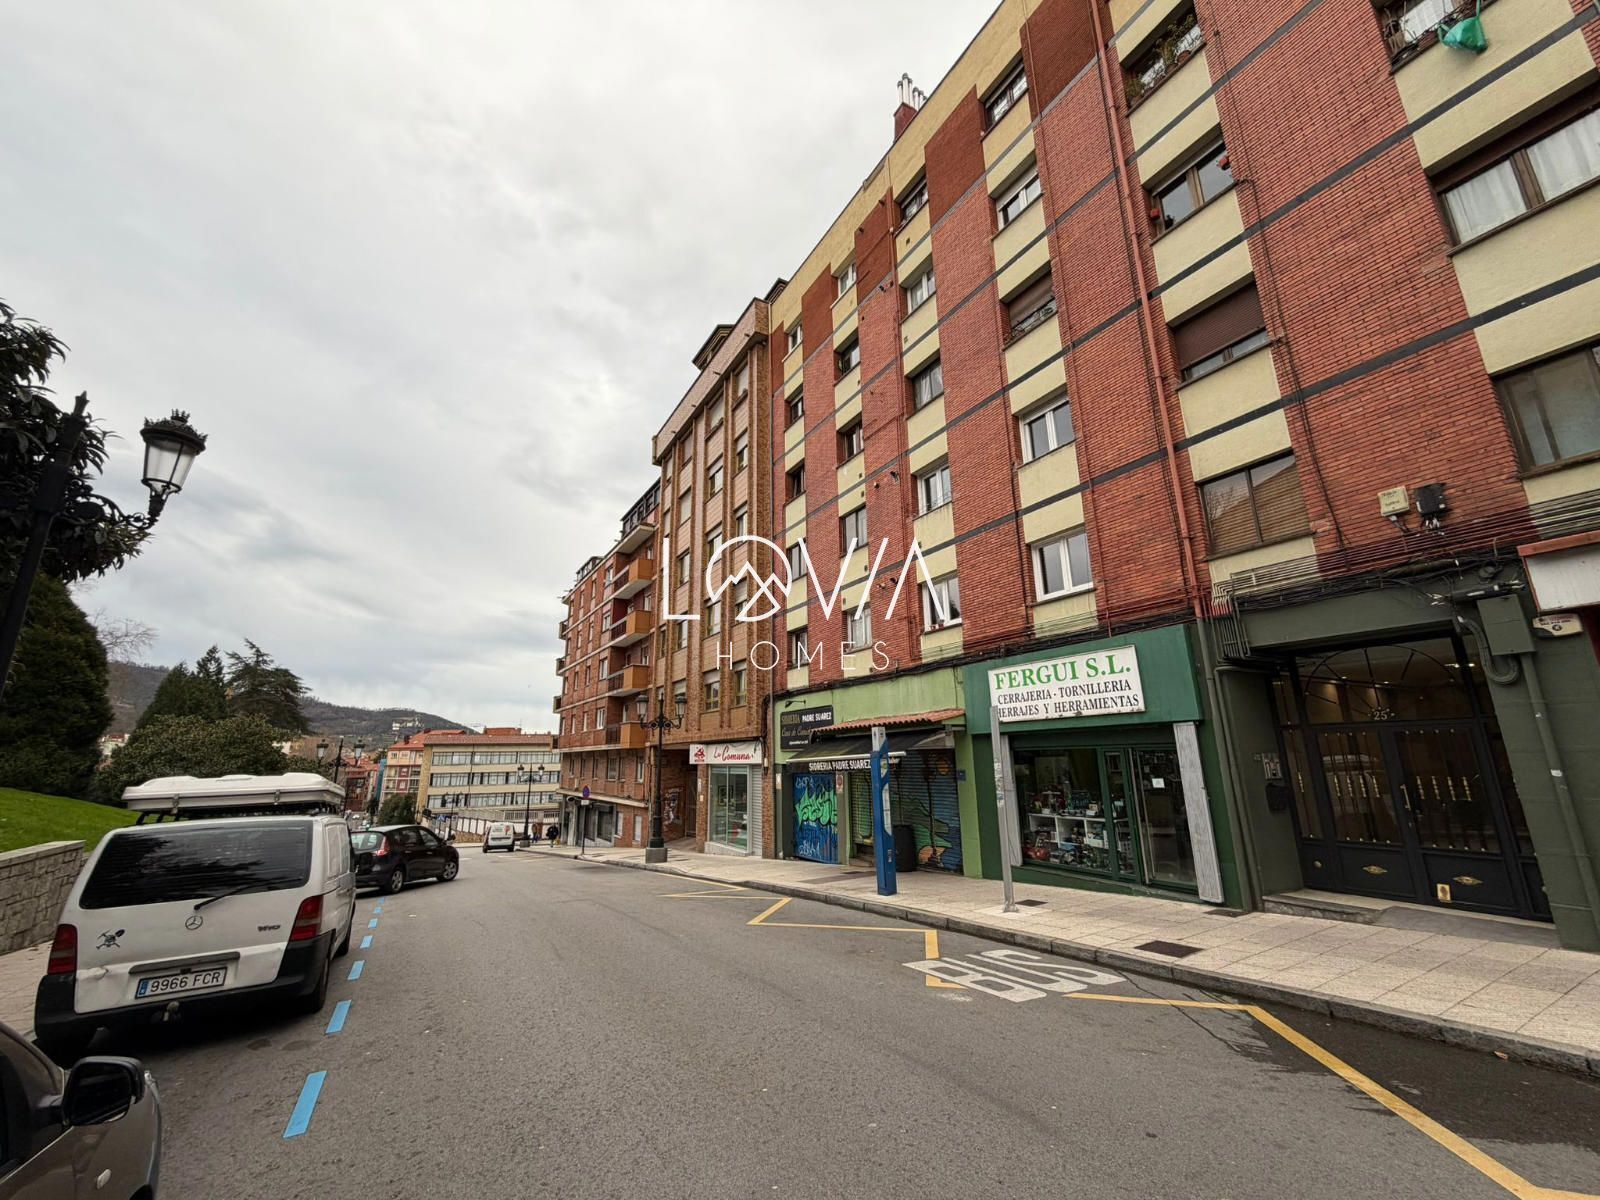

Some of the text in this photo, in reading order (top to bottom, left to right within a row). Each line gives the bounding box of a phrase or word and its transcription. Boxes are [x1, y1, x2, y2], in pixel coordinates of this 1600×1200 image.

[994, 655, 1131, 690] FERGUI S.L.
[998, 689, 1051, 705] CERRAJERIA
[1058, 679, 1132, 698] TORNILLERIA
[1043, 703, 1050, 714] Y
[1054, 694, 1140, 713] HERRAMIENTAS
[802, 713, 815, 722] PADRE
[815, 711, 832, 721] SUAREZ
[1374, 710, 1388, 720] 25
[713, 745, 751, 761] La Comuna
[832, 760, 850, 770] PADRE
[850, 759, 871, 769] SUAREZ
[150, 976, 189, 993] 9966
[192, 971, 221, 987] FCR
[902, 949, 1127, 1003] BUS
